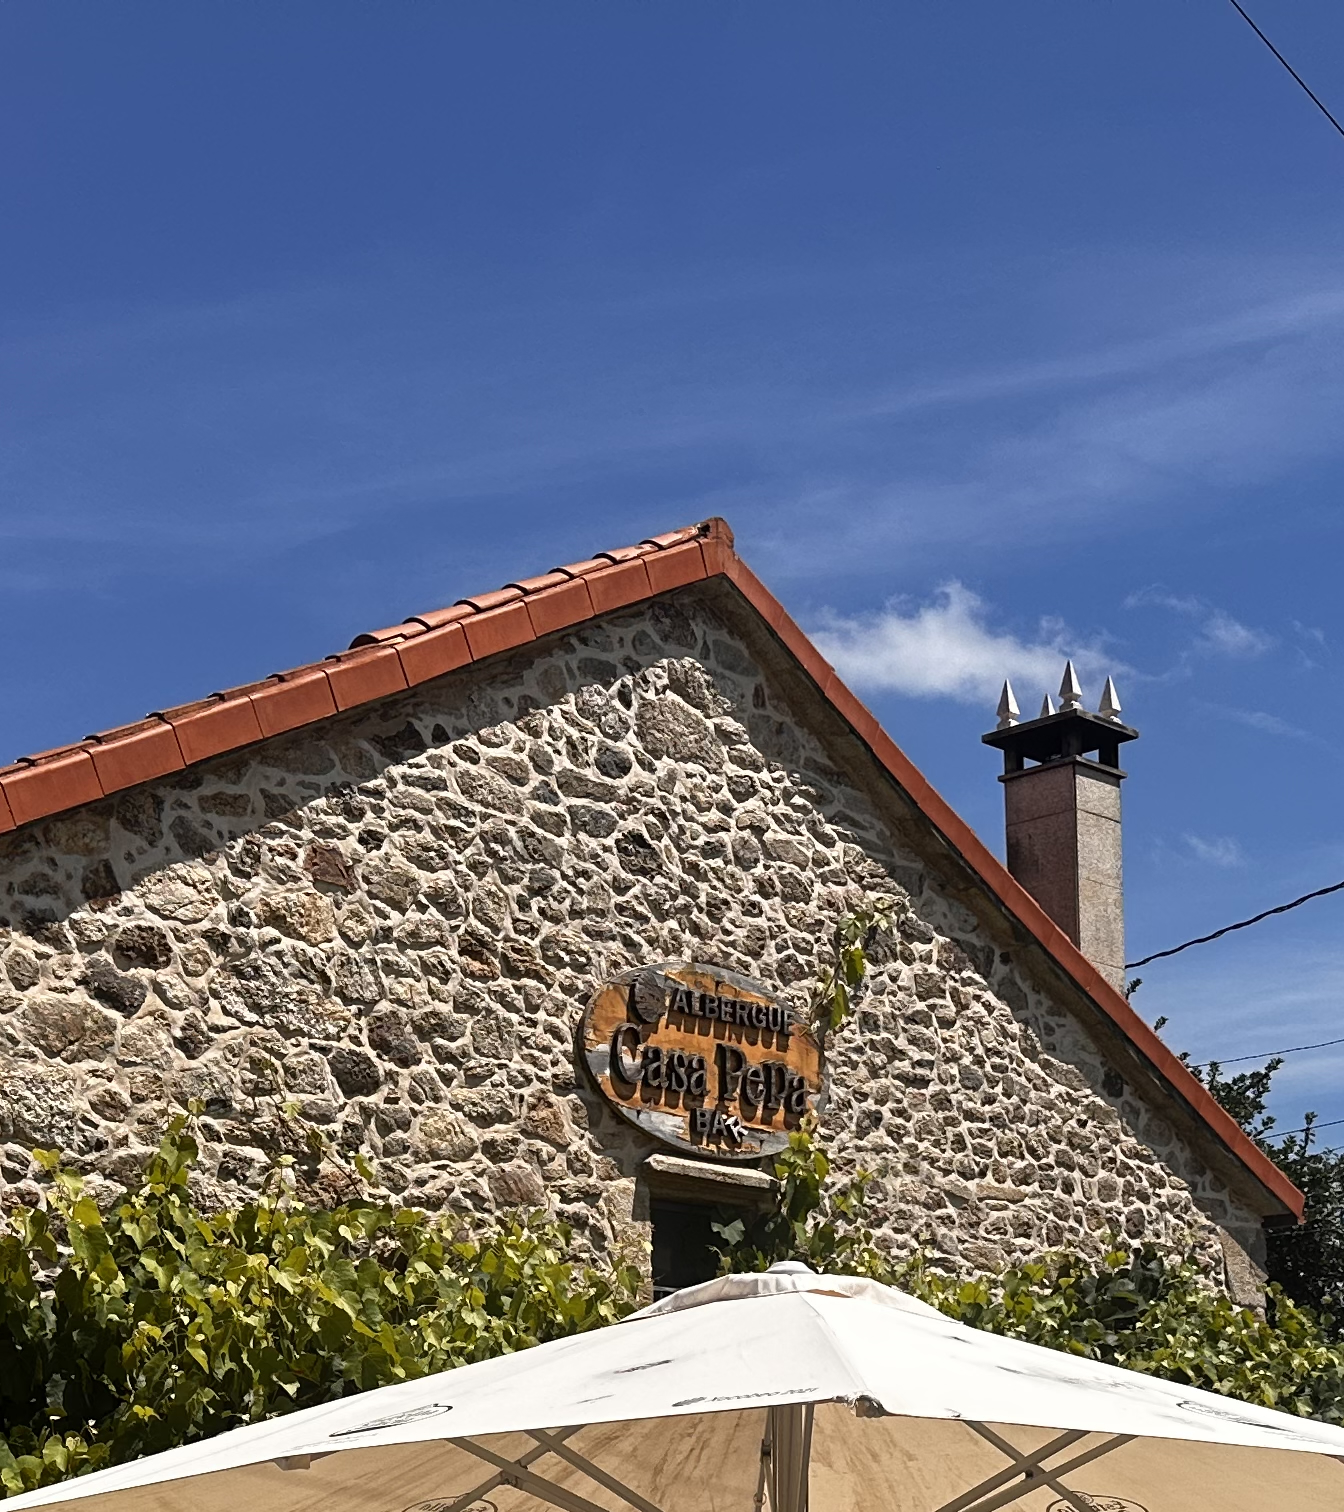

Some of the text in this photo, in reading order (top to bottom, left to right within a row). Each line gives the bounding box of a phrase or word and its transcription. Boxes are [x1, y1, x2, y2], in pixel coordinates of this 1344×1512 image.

[671, 989, 796, 1035] ALBERGUE
[612, 1023, 807, 1113] Casa Pepa
[693, 1108, 749, 1143] BAR
